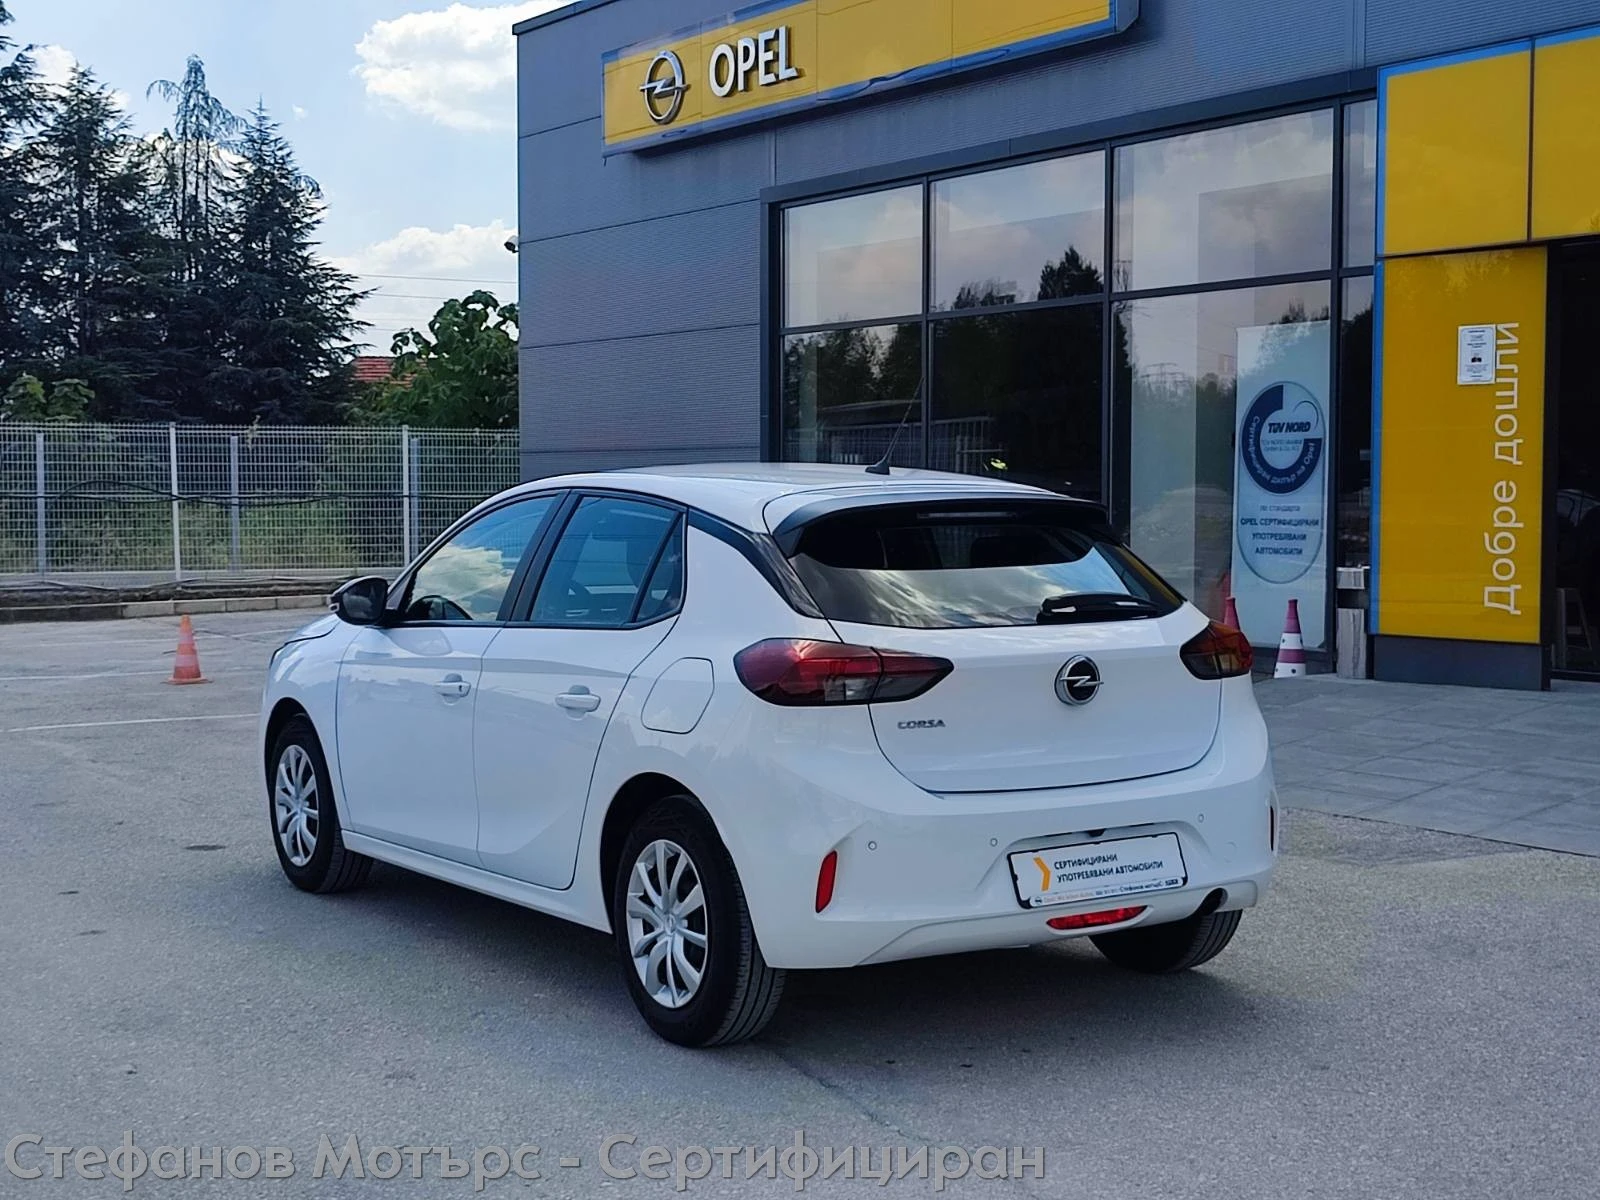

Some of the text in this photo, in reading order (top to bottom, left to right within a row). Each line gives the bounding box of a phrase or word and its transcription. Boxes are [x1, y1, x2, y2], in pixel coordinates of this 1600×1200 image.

[709, 25, 799, 98] OPEL
[1285, 421, 1312, 433] NORD
[1303, 442, 1317, 465] Opel
[1484, 322, 1524, 615] Добре дошли
[1240, 518, 1258, 526] OPEL
[897, 719, 946, 730] CORSA
[1053, 853, 1118, 870] СЕРТИФИЦИРАНИ
[1057, 861, 1164, 883] УПОТРЕБЯВАНИ АВТОМОБИЛИ
